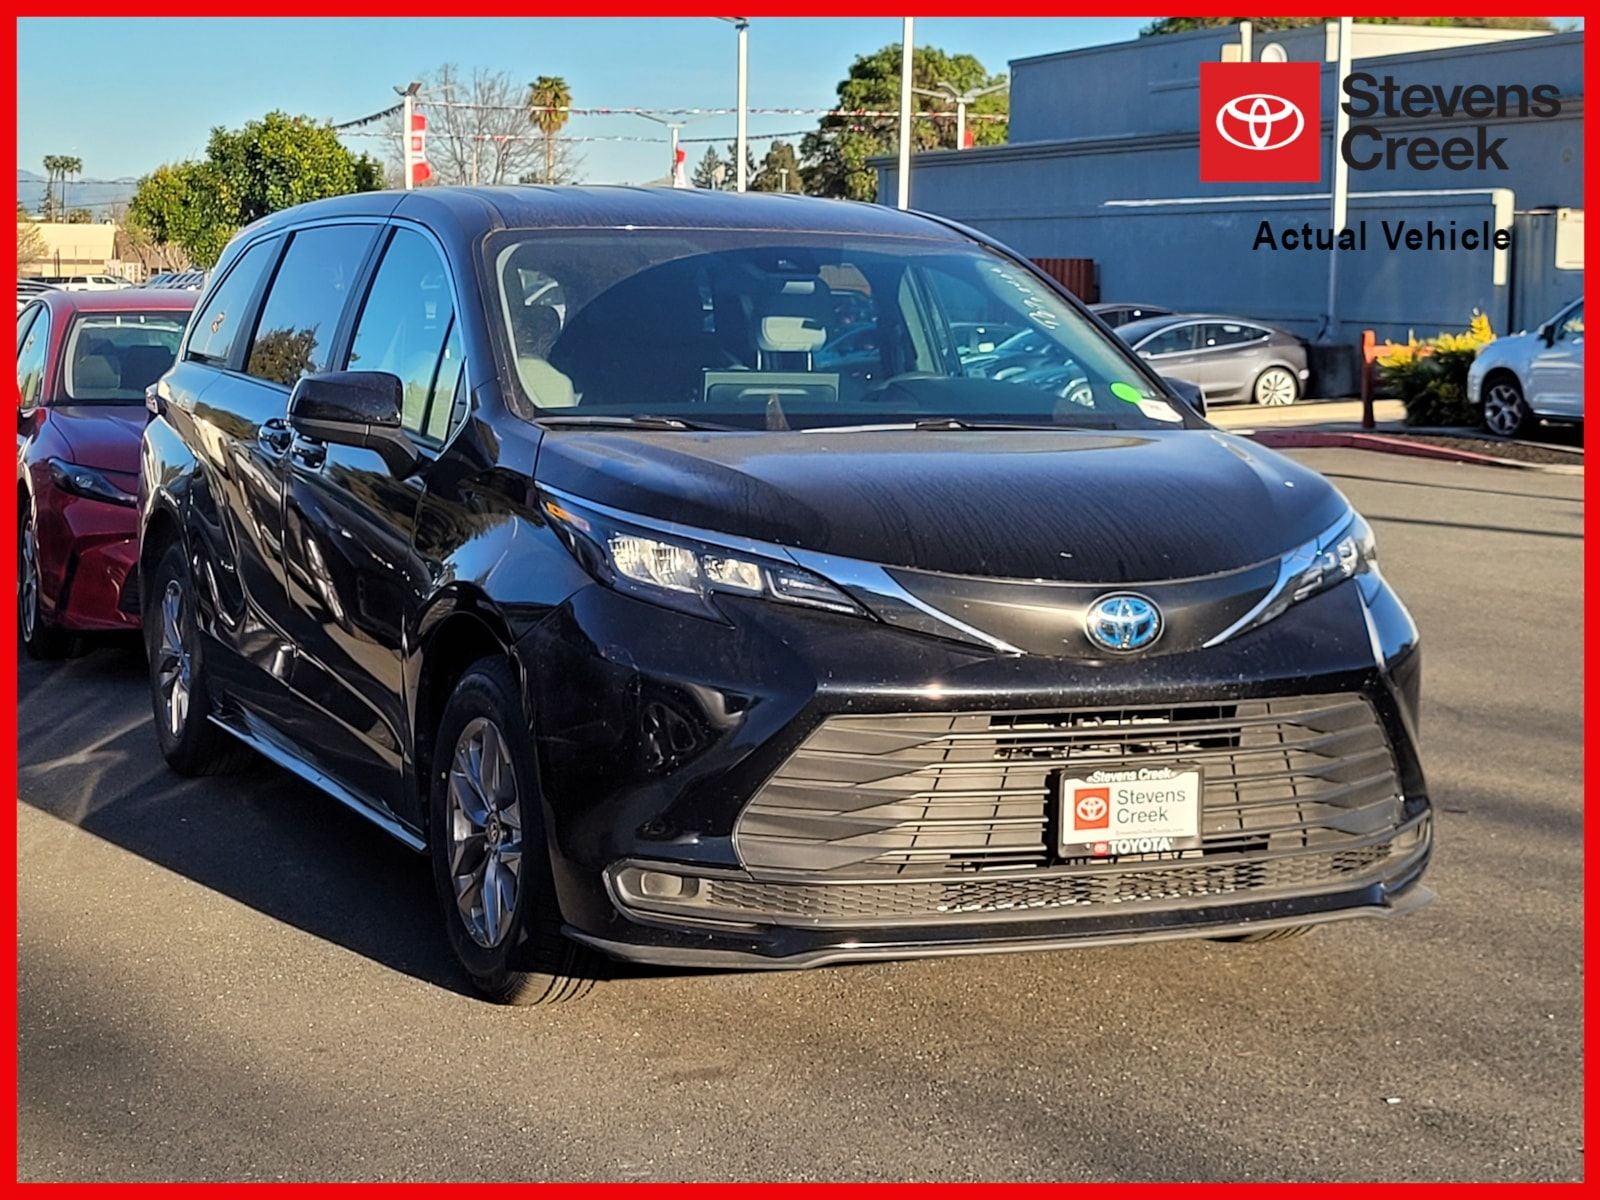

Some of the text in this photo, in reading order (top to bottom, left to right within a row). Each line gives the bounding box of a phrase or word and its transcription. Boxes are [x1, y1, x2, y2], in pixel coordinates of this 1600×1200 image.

[1093, 767, 1172, 783] Stevens Creek
[1116, 789, 1186, 806] Stevens
[1116, 806, 1169, 824] Creek
[1109, 837, 1172, 855] TOYOTA
